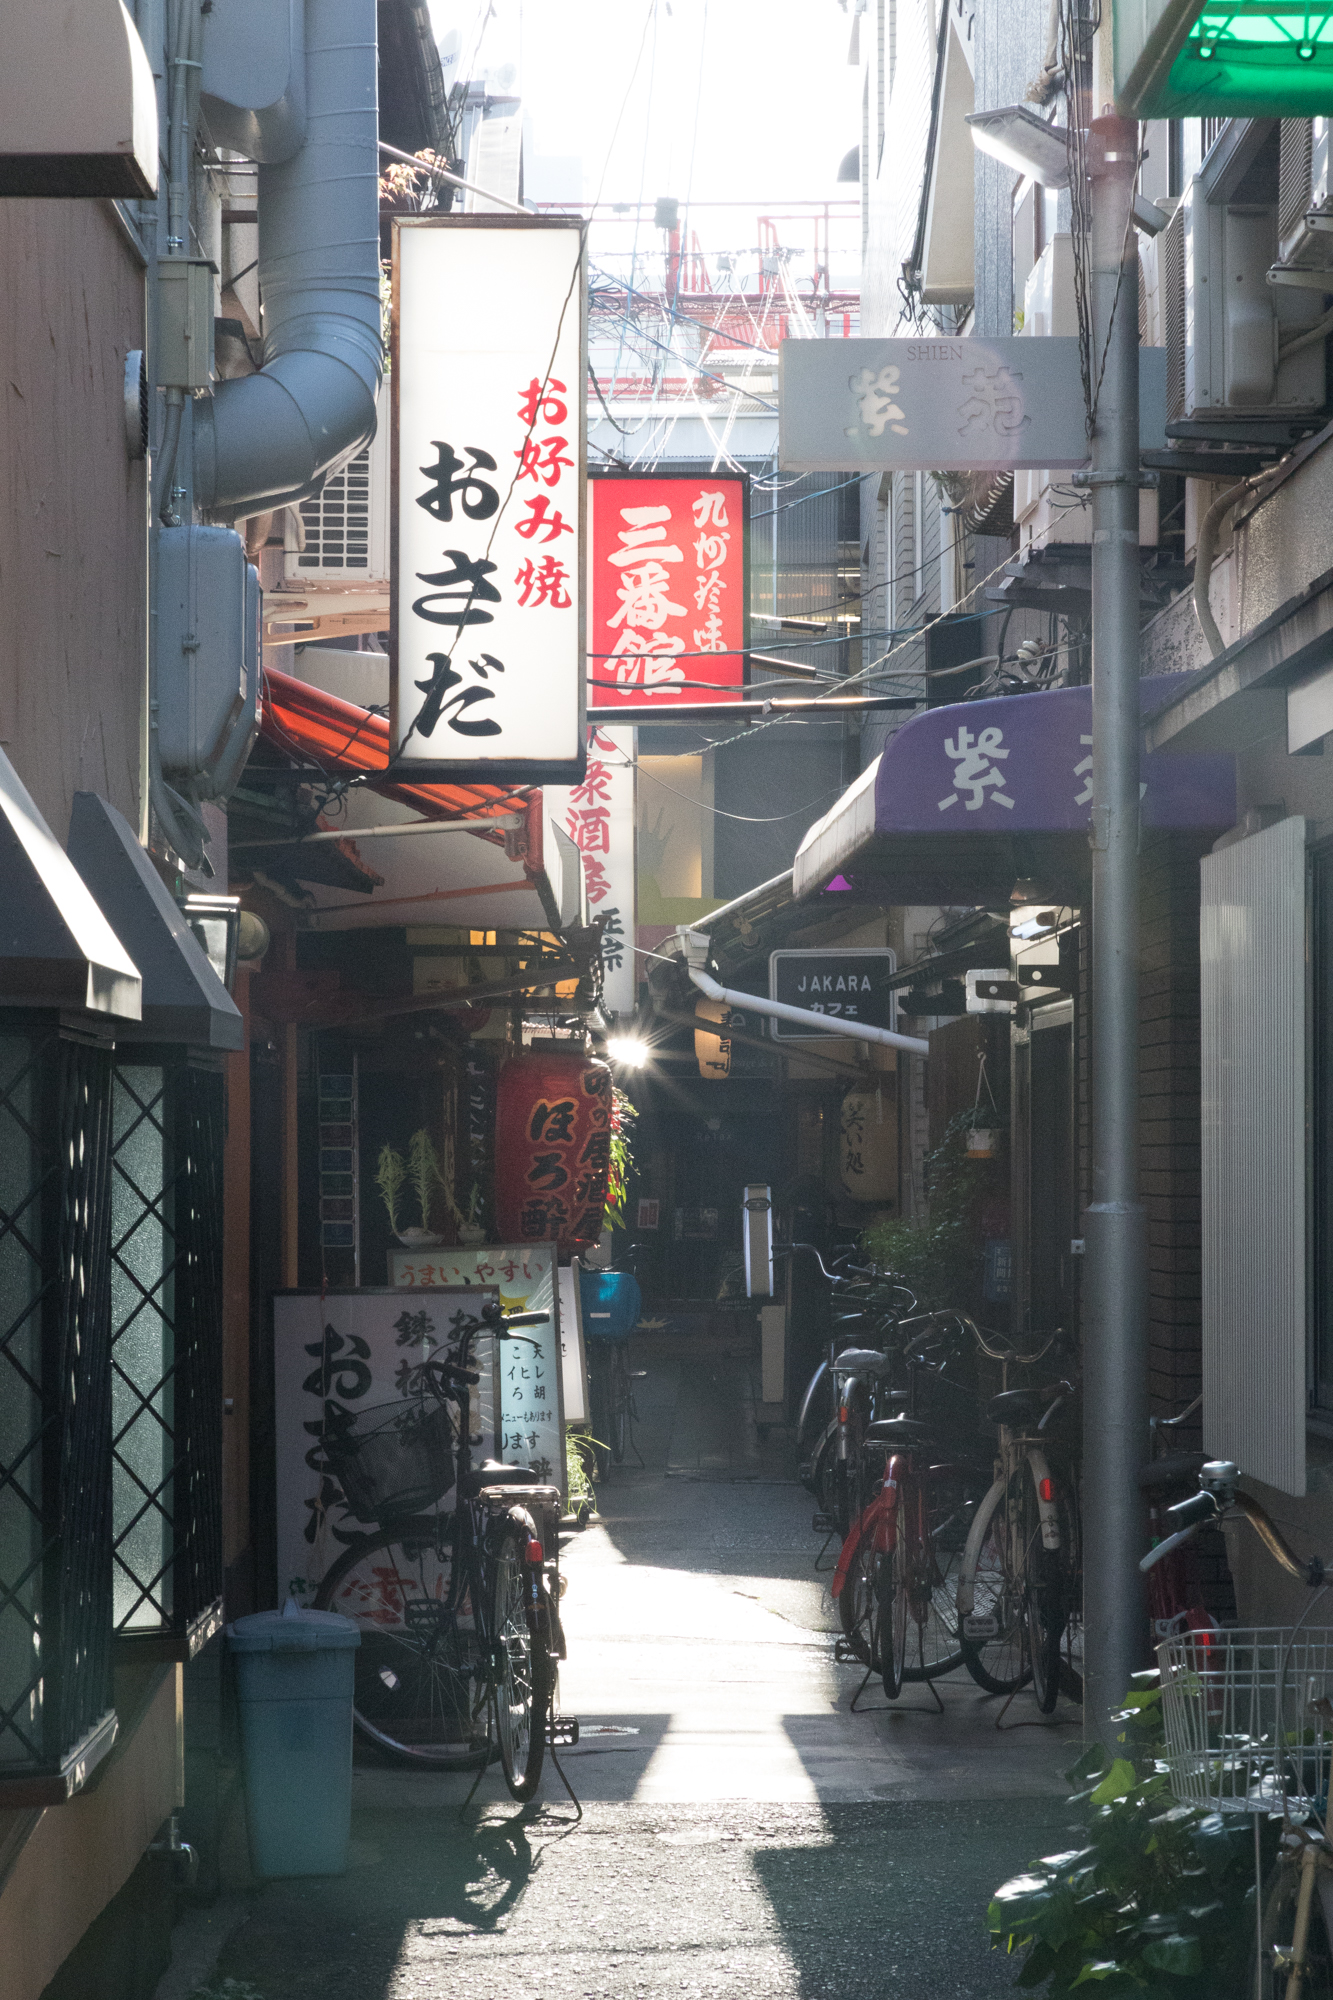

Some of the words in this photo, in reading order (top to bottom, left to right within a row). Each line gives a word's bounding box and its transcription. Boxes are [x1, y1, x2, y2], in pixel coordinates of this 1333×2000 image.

[844, 364, 1032, 438] 紫苑
[907, 345, 964, 363] SHIEN
[513, 377, 574, 609] お好み焼
[412, 440, 505, 738] おさだ
[602, 505, 688, 696] 三番館
[692, 490, 730, 653] 九州珍味
[937, 726, 1148, 811] 紫
[797, 974, 872, 992] JAKARA
[809, 1001, 858, 1016] カフェ
[520, 1098, 579, 1239] ほろ酔
